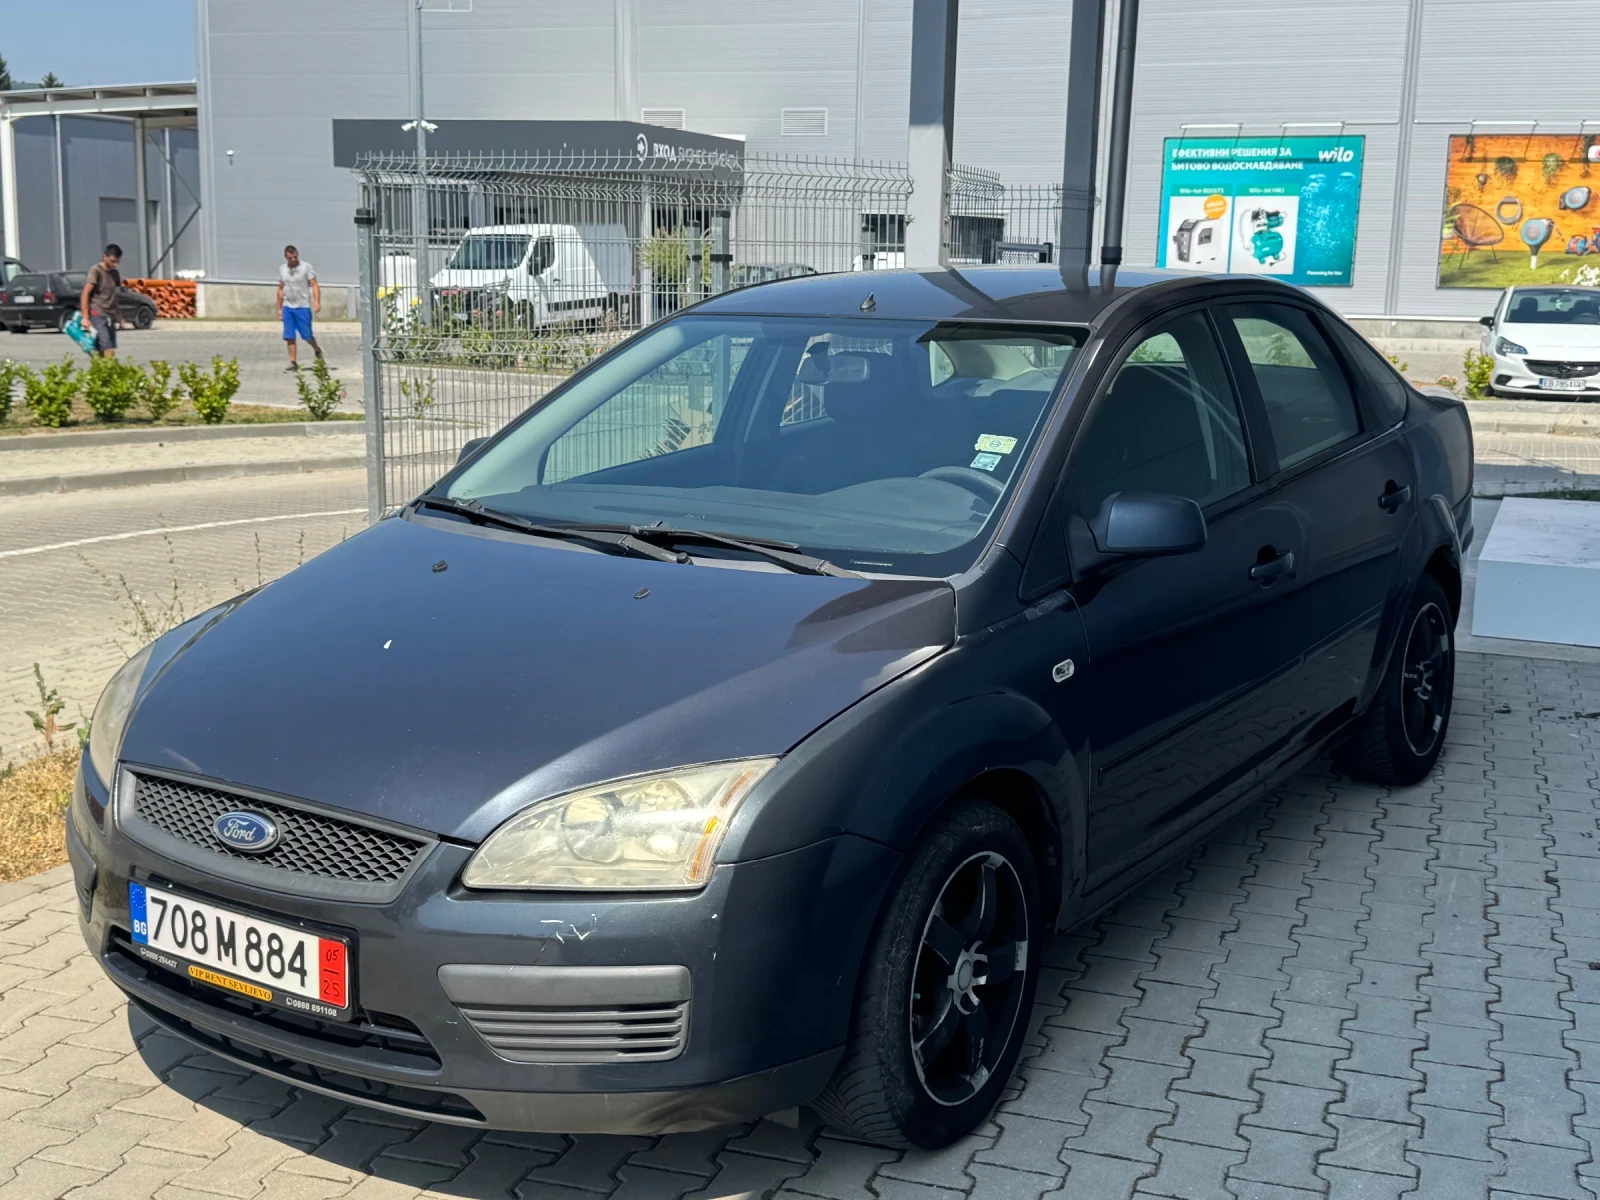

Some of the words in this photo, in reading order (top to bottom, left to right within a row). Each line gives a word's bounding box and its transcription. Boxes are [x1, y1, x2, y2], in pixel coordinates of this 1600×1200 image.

[653, 143, 677, 163] ВХОД
[1231, 147, 1277, 157] РЕШЕНИЯ
[1279, 147, 1292, 157] ЗА
[1318, 147, 1354, 163] wilo
[1171, 162, 1211, 171] БИТОВО
[1212, 161, 1304, 171] ВОДОСНАБДЯВАНЕ
[223, 818, 257, 841] Ford
[134, 919, 147, 935] BG
[325, 949, 340, 962] 05
[190, 967, 204, 978] VIP
[205, 973, 228, 984] RENT
[228, 980, 271, 1000] SEVLIEVO
[323, 980, 340, 998] 25
[292, 998, 310, 1011] 0888
[311, 1003, 338, 1017] 891108
